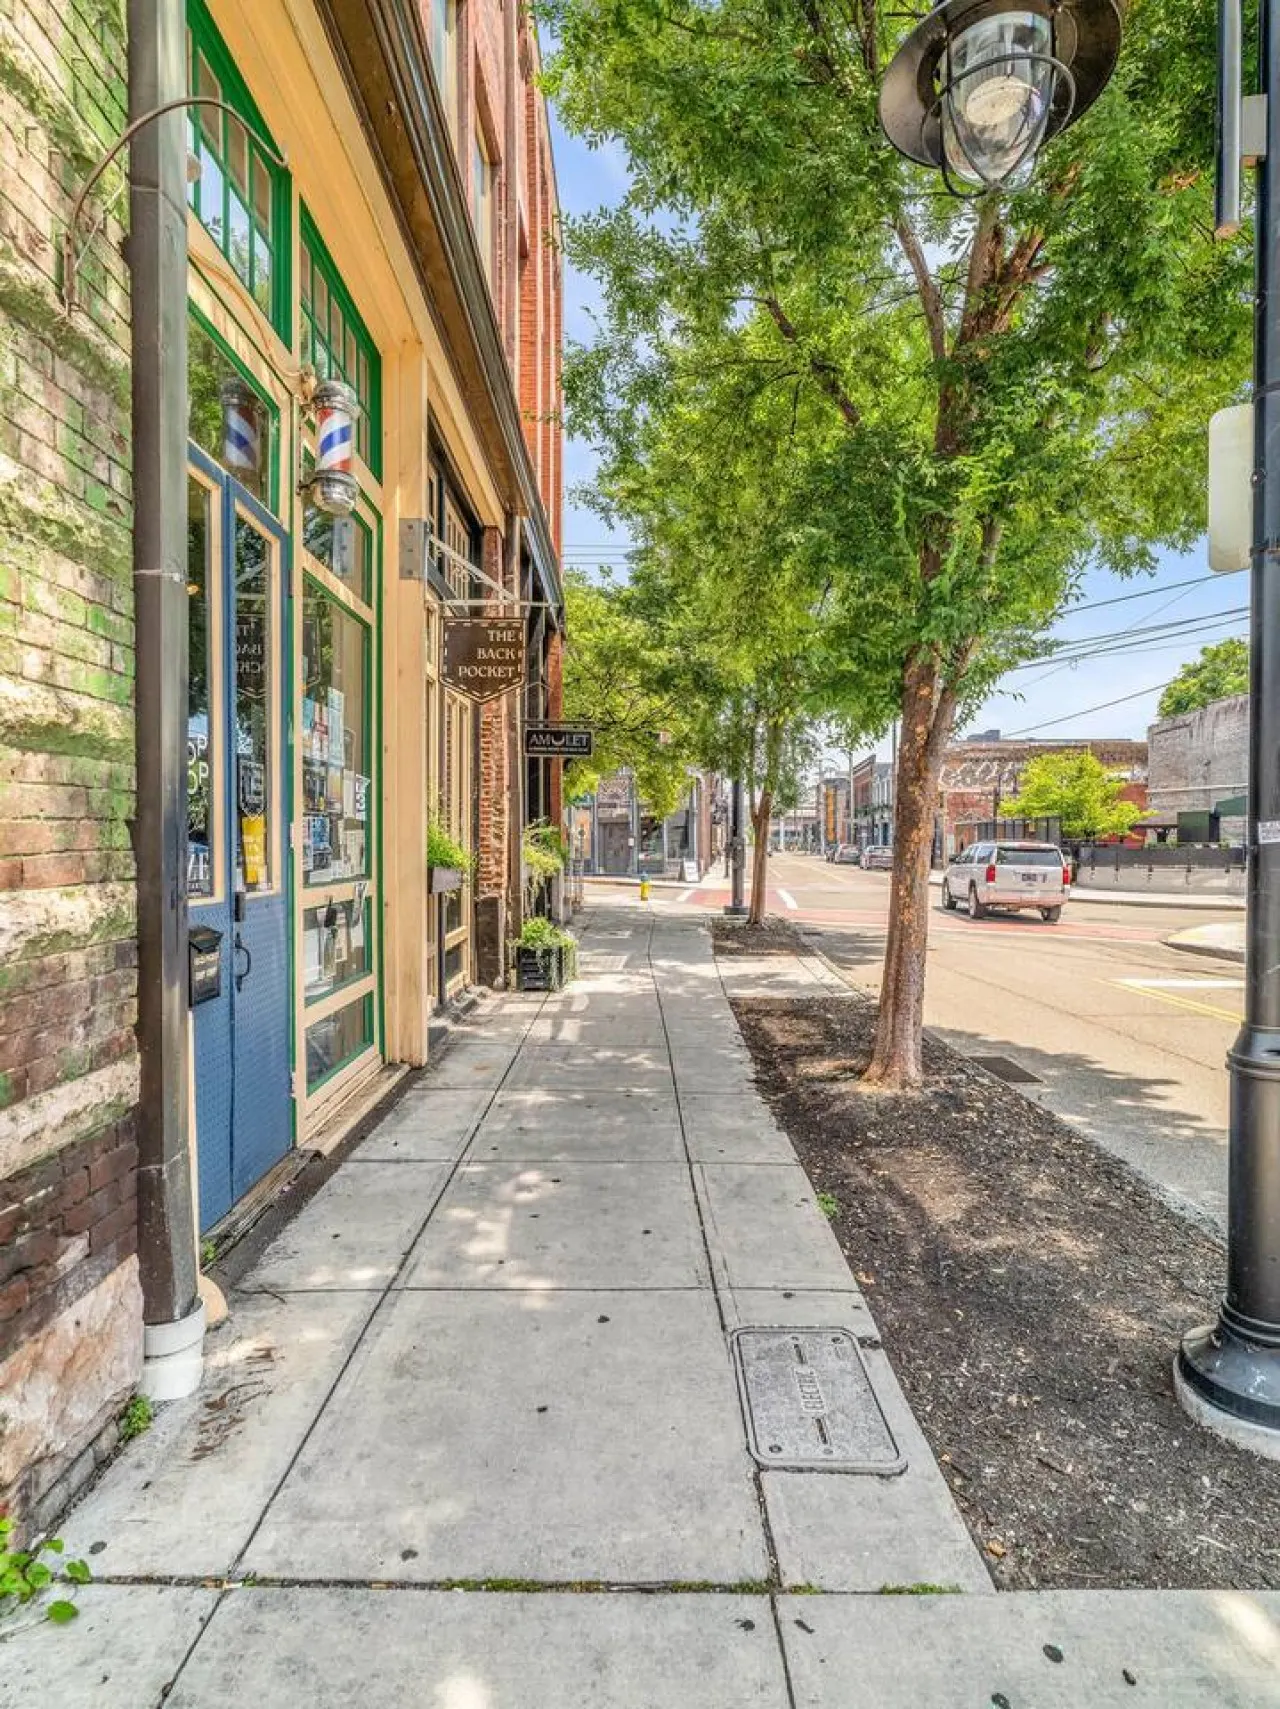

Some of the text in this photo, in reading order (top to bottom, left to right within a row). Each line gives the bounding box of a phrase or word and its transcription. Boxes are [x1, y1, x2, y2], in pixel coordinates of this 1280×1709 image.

[487, 629, 516, 642] THE
[476, 647, 516, 660] BACK
[458, 665, 515, 678] POCKET
[529, 733, 589, 747] AMULET
